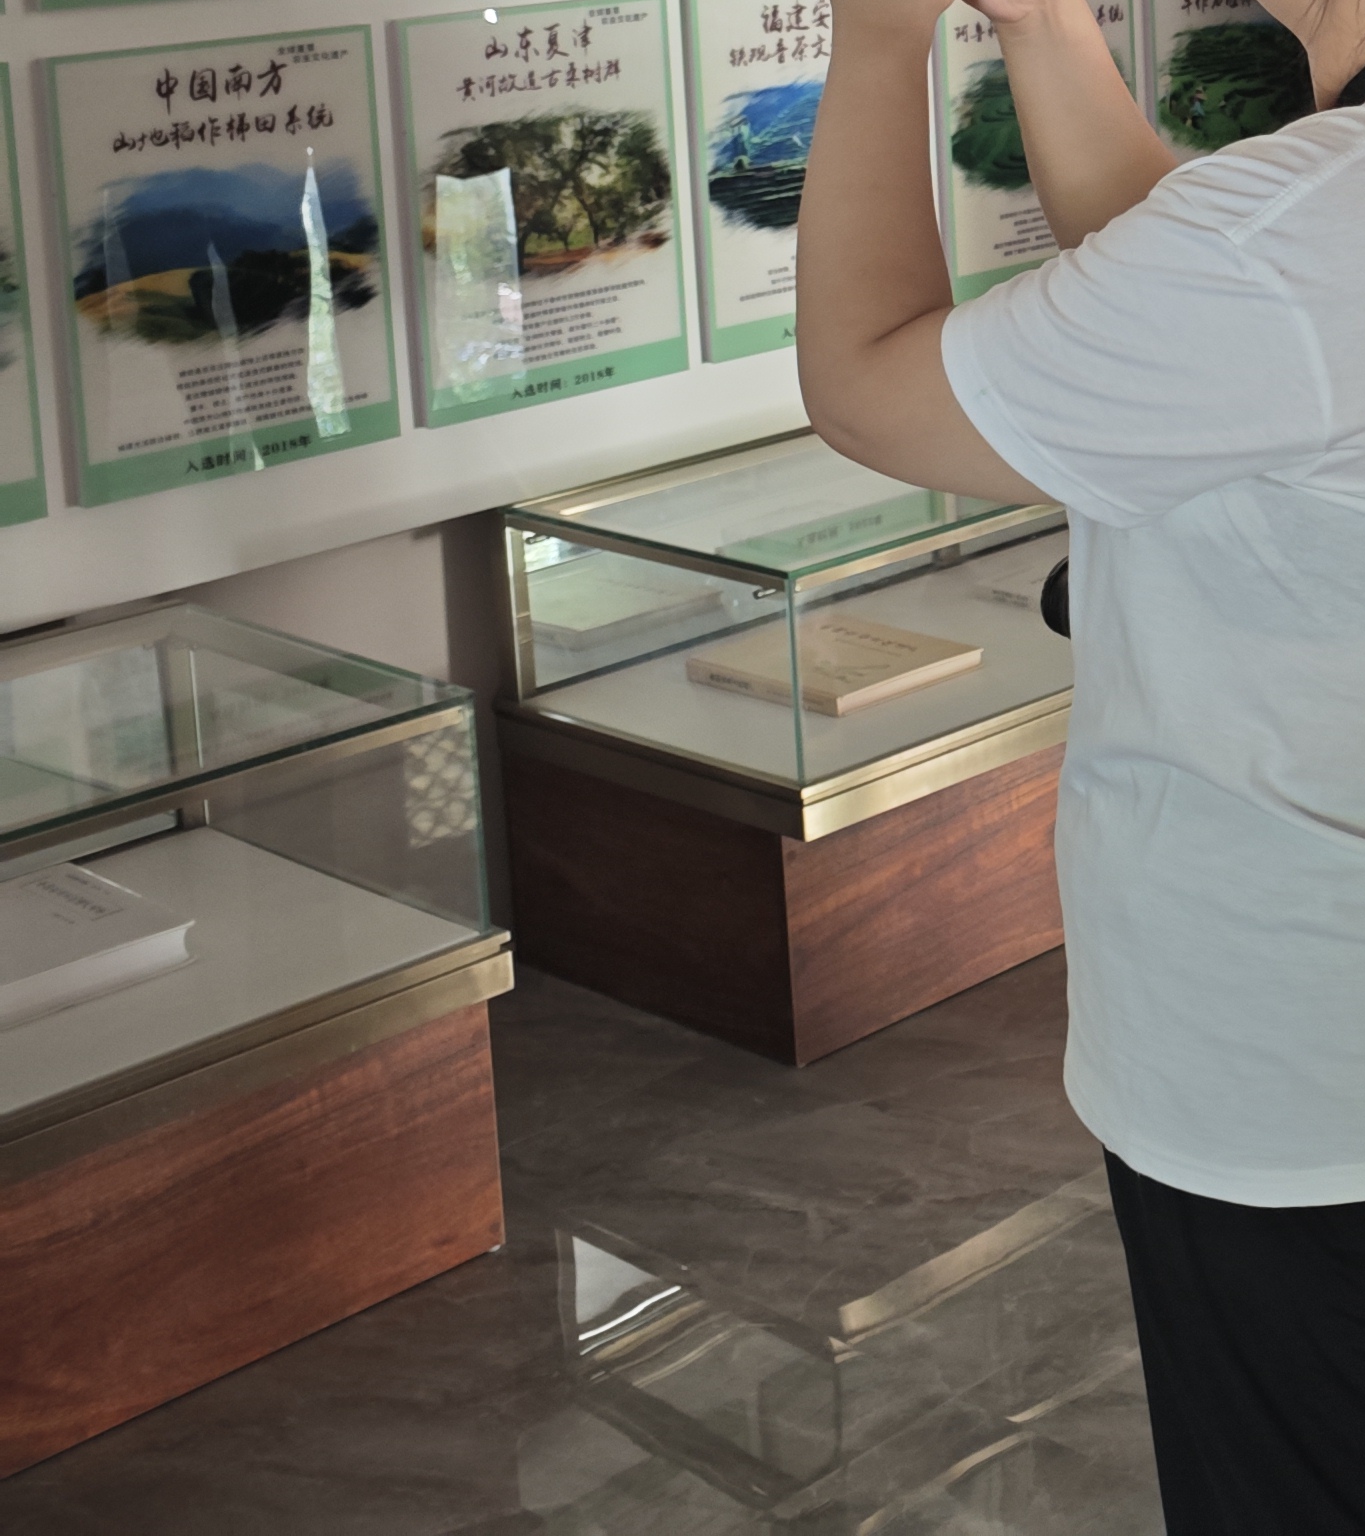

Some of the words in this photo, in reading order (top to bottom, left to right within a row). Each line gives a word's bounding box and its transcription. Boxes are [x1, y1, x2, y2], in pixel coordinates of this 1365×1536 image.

[484, 19, 593, 63] 山东夏津
[155, 60, 288, 115] 中国南方
[113, 103, 334, 154] 山地稻作梯田系统
